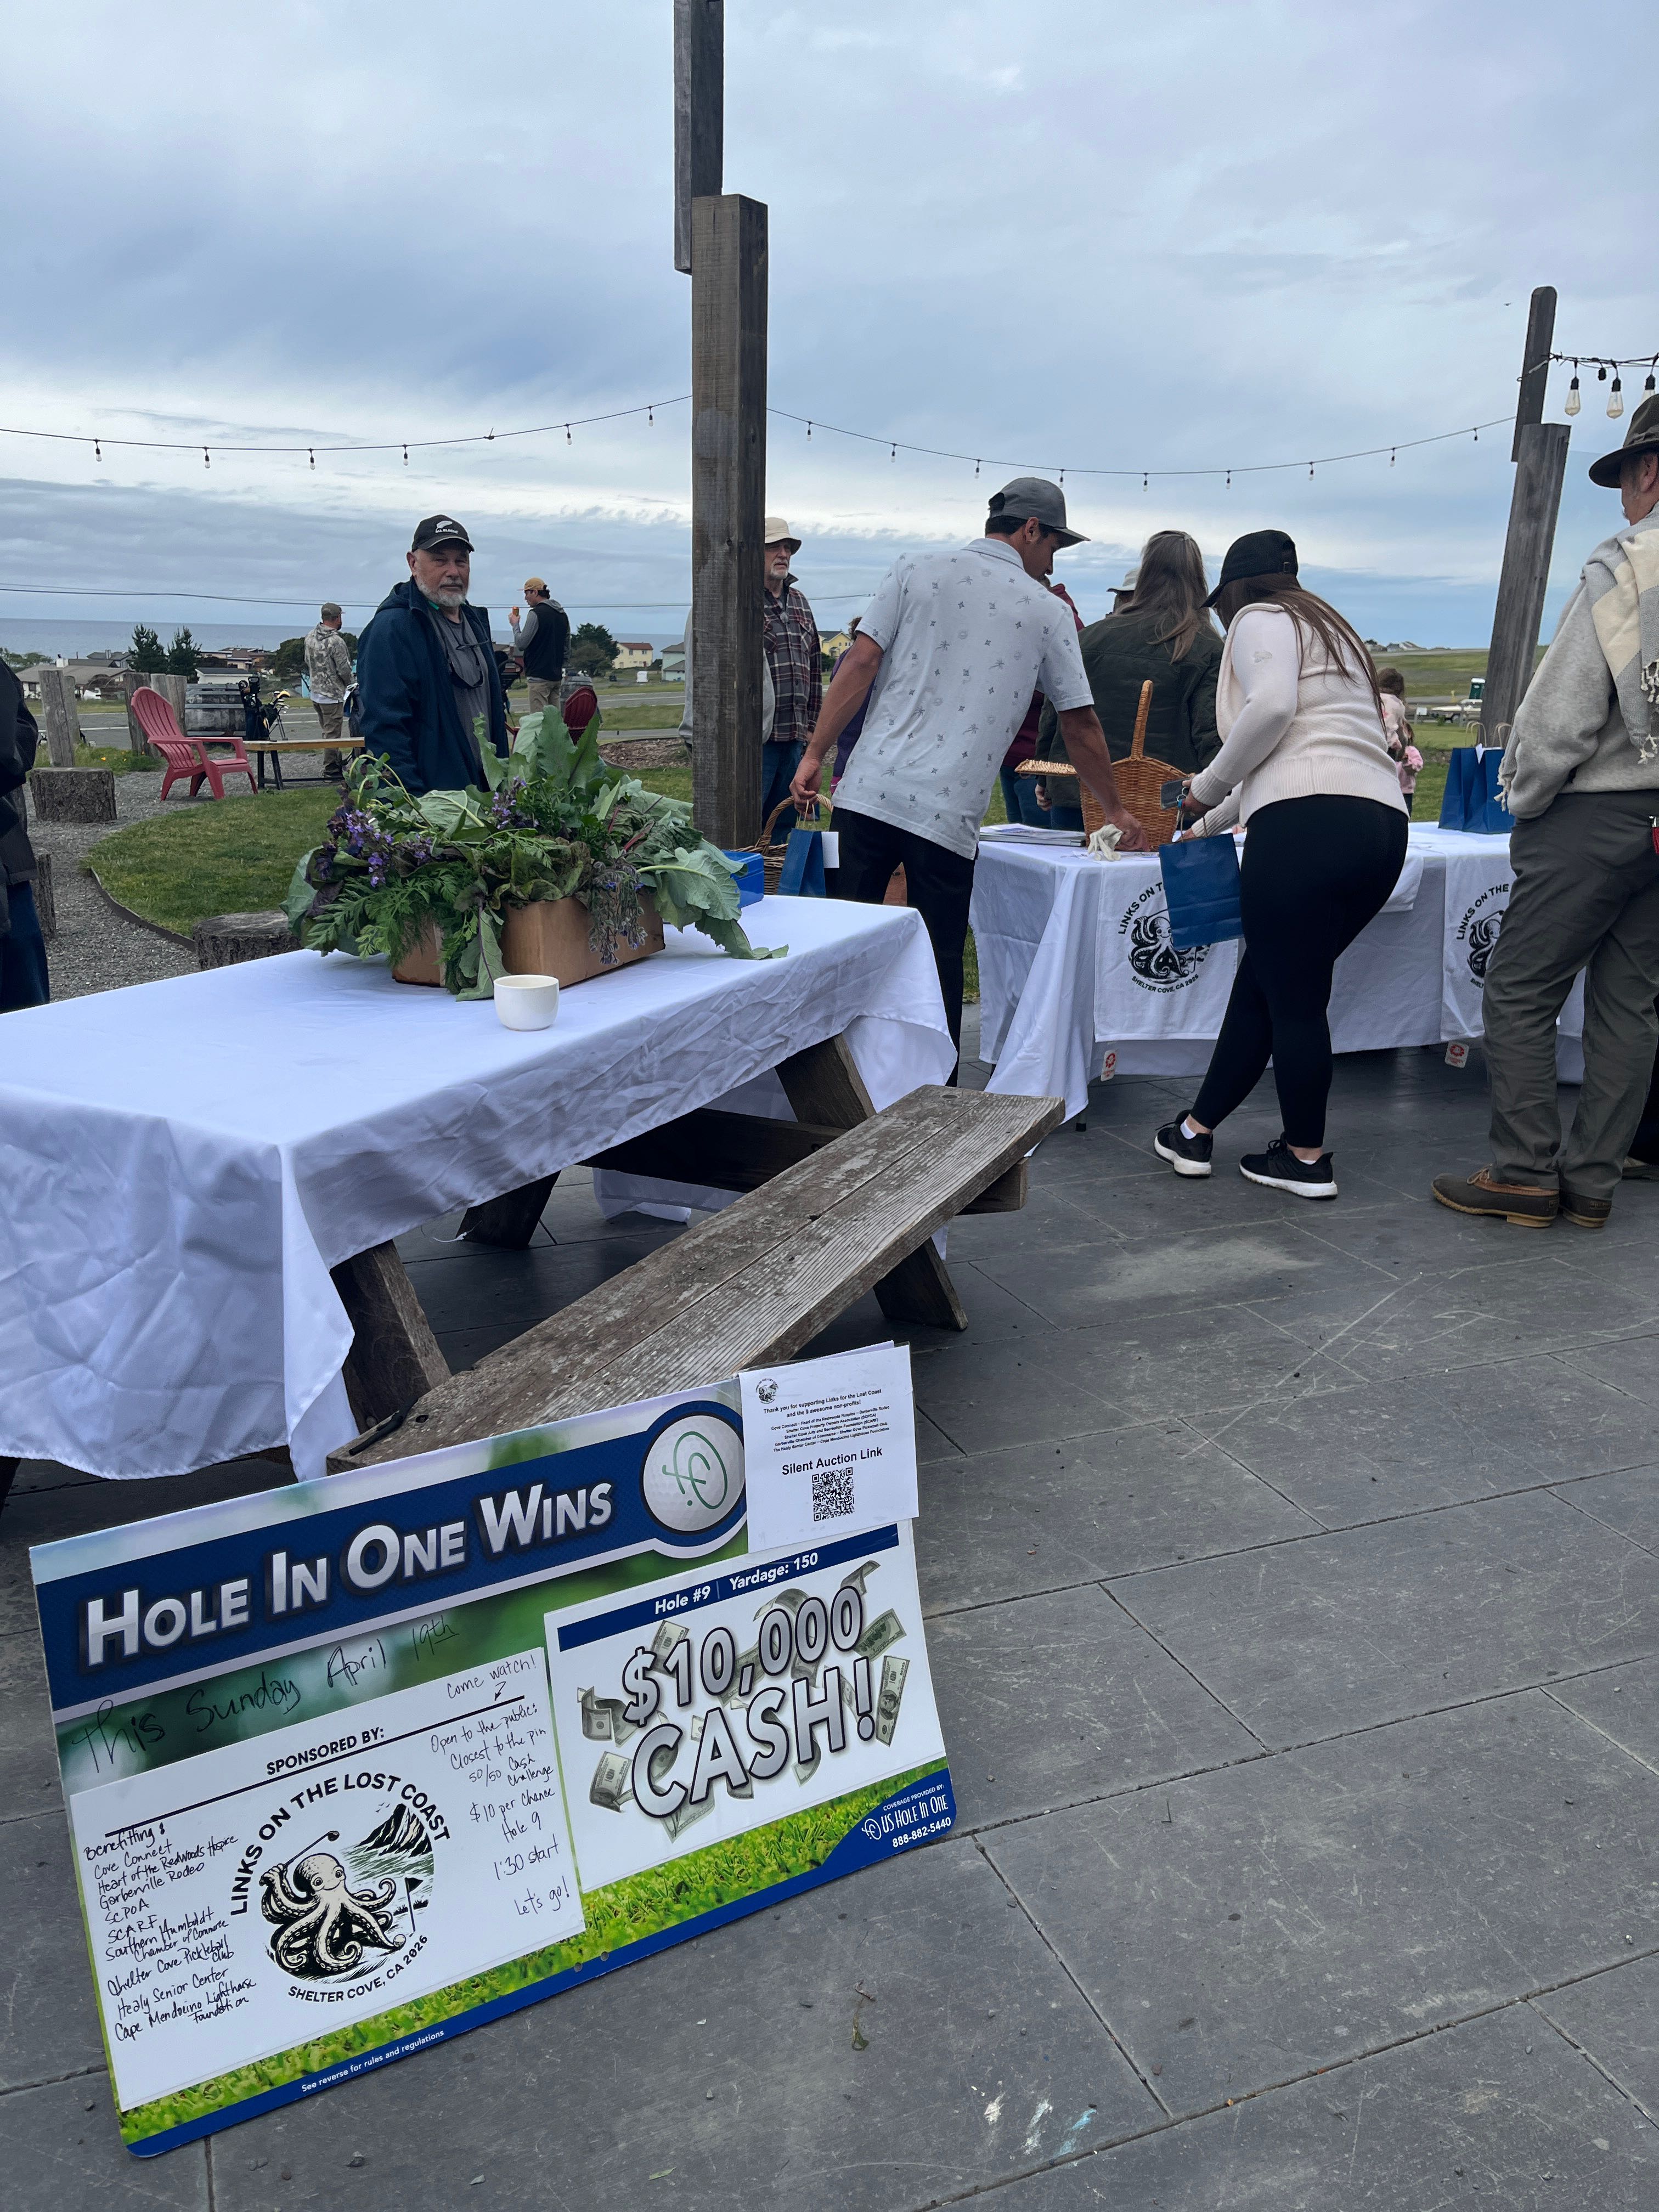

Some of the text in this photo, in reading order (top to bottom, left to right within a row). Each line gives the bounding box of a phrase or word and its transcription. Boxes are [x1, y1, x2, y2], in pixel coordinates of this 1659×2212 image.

[1118, 887, 1155, 935] LINKS ON
[1456, 883, 1509, 940] LINKS ON THE
[1131, 976, 1156, 992] SHELTER
[798, 1399, 825, 1408] supporting
[782, 1447, 883, 1475] Silent Auction Link
[87, 1578, 249, 1667] HOLE
[347, 1521, 466, 1590] ONE
[479, 1482, 613, 1554] WINS
[654, 1551, 819, 1615] Hole #9 Yardage: 150
[187, 1671, 301, 1732] Sunday
[327, 1639, 388, 1688] April
[412, 1614, 460, 1662] 19th
[489, 1654, 537, 1680] watch!
[622, 1585, 864, 1728] $10,000
[430, 1703, 537, 1755] Open to the public:
[450, 1728, 546, 1770] Closest to the pin
[631, 1656, 875, 1818] CASH!
[267, 1727, 385, 1775] SPONSORED BY:
[469, 1764, 501, 1787] 50/50
[498, 1798, 516, 1820] per
[881, 1813, 895, 1833] US
[894, 1805, 919, 1829] HOLE
[883, 1796, 911, 1811] COVERAGE
[911, 1787, 936, 1801] PROVIDED
[230, 1771, 451, 1916] LINKS ON THE LOST COAST
[501, 1811, 541, 1843] Hole 9
[892, 1817, 952, 1848] 888-882-5440
[94, 1838, 172, 1880] Cove Connect
[494, 1833, 559, 1881] 1:30 start
[98, 1871, 127, 1895] Heart
[131, 1867, 141, 1882] of
[140, 1864, 160, 1877] the
[99, 1862, 205, 1911] Garberville Rodeo
[514, 1875, 570, 1915] Let's go!
[108, 1914, 158, 1944] SCARF
[157, 1960, 182, 1973] Cove
[287, 1934, 428, 2003] SHELTER COVE, CA 2026
[118, 1966, 229, 2021] Healy Senior Center
[114, 2022, 144, 2042] Cape
[301, 2030, 445, 2092] See reverse for rules and regulations
